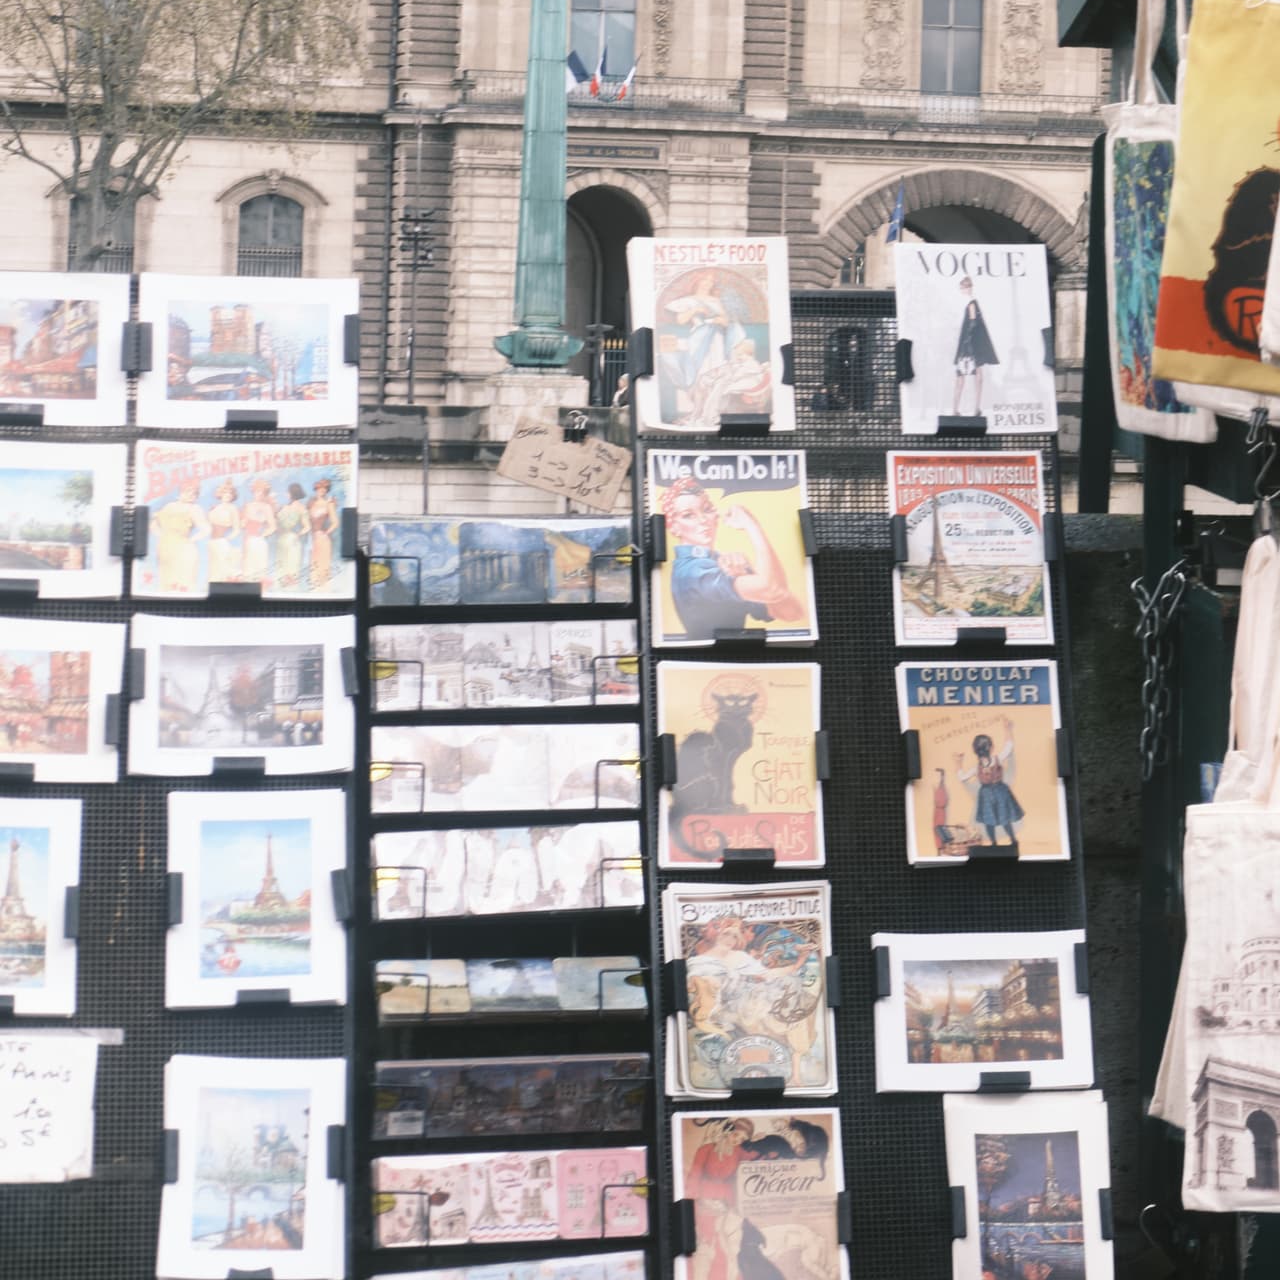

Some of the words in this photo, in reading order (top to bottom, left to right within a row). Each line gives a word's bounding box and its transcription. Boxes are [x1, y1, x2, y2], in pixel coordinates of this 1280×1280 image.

[728, 243, 768, 263] FOOD
[916, 250, 1027, 278] VOGUE
[993, 413, 1046, 427] PARIS
[656, 455, 692, 480] We
[694, 455, 734, 480] Can
[737, 455, 769, 480] Do
[771, 455, 797, 480] It!
[896, 463, 964, 485] EXPOSITION
[965, 463, 1037, 485] UNIVERSELLE
[920, 666, 1033, 683] CHOCOLAT
[916, 684, 1041, 705] MENIER
[751, 757, 806, 786] CHAT
[754, 781, 813, 808] NOIR
